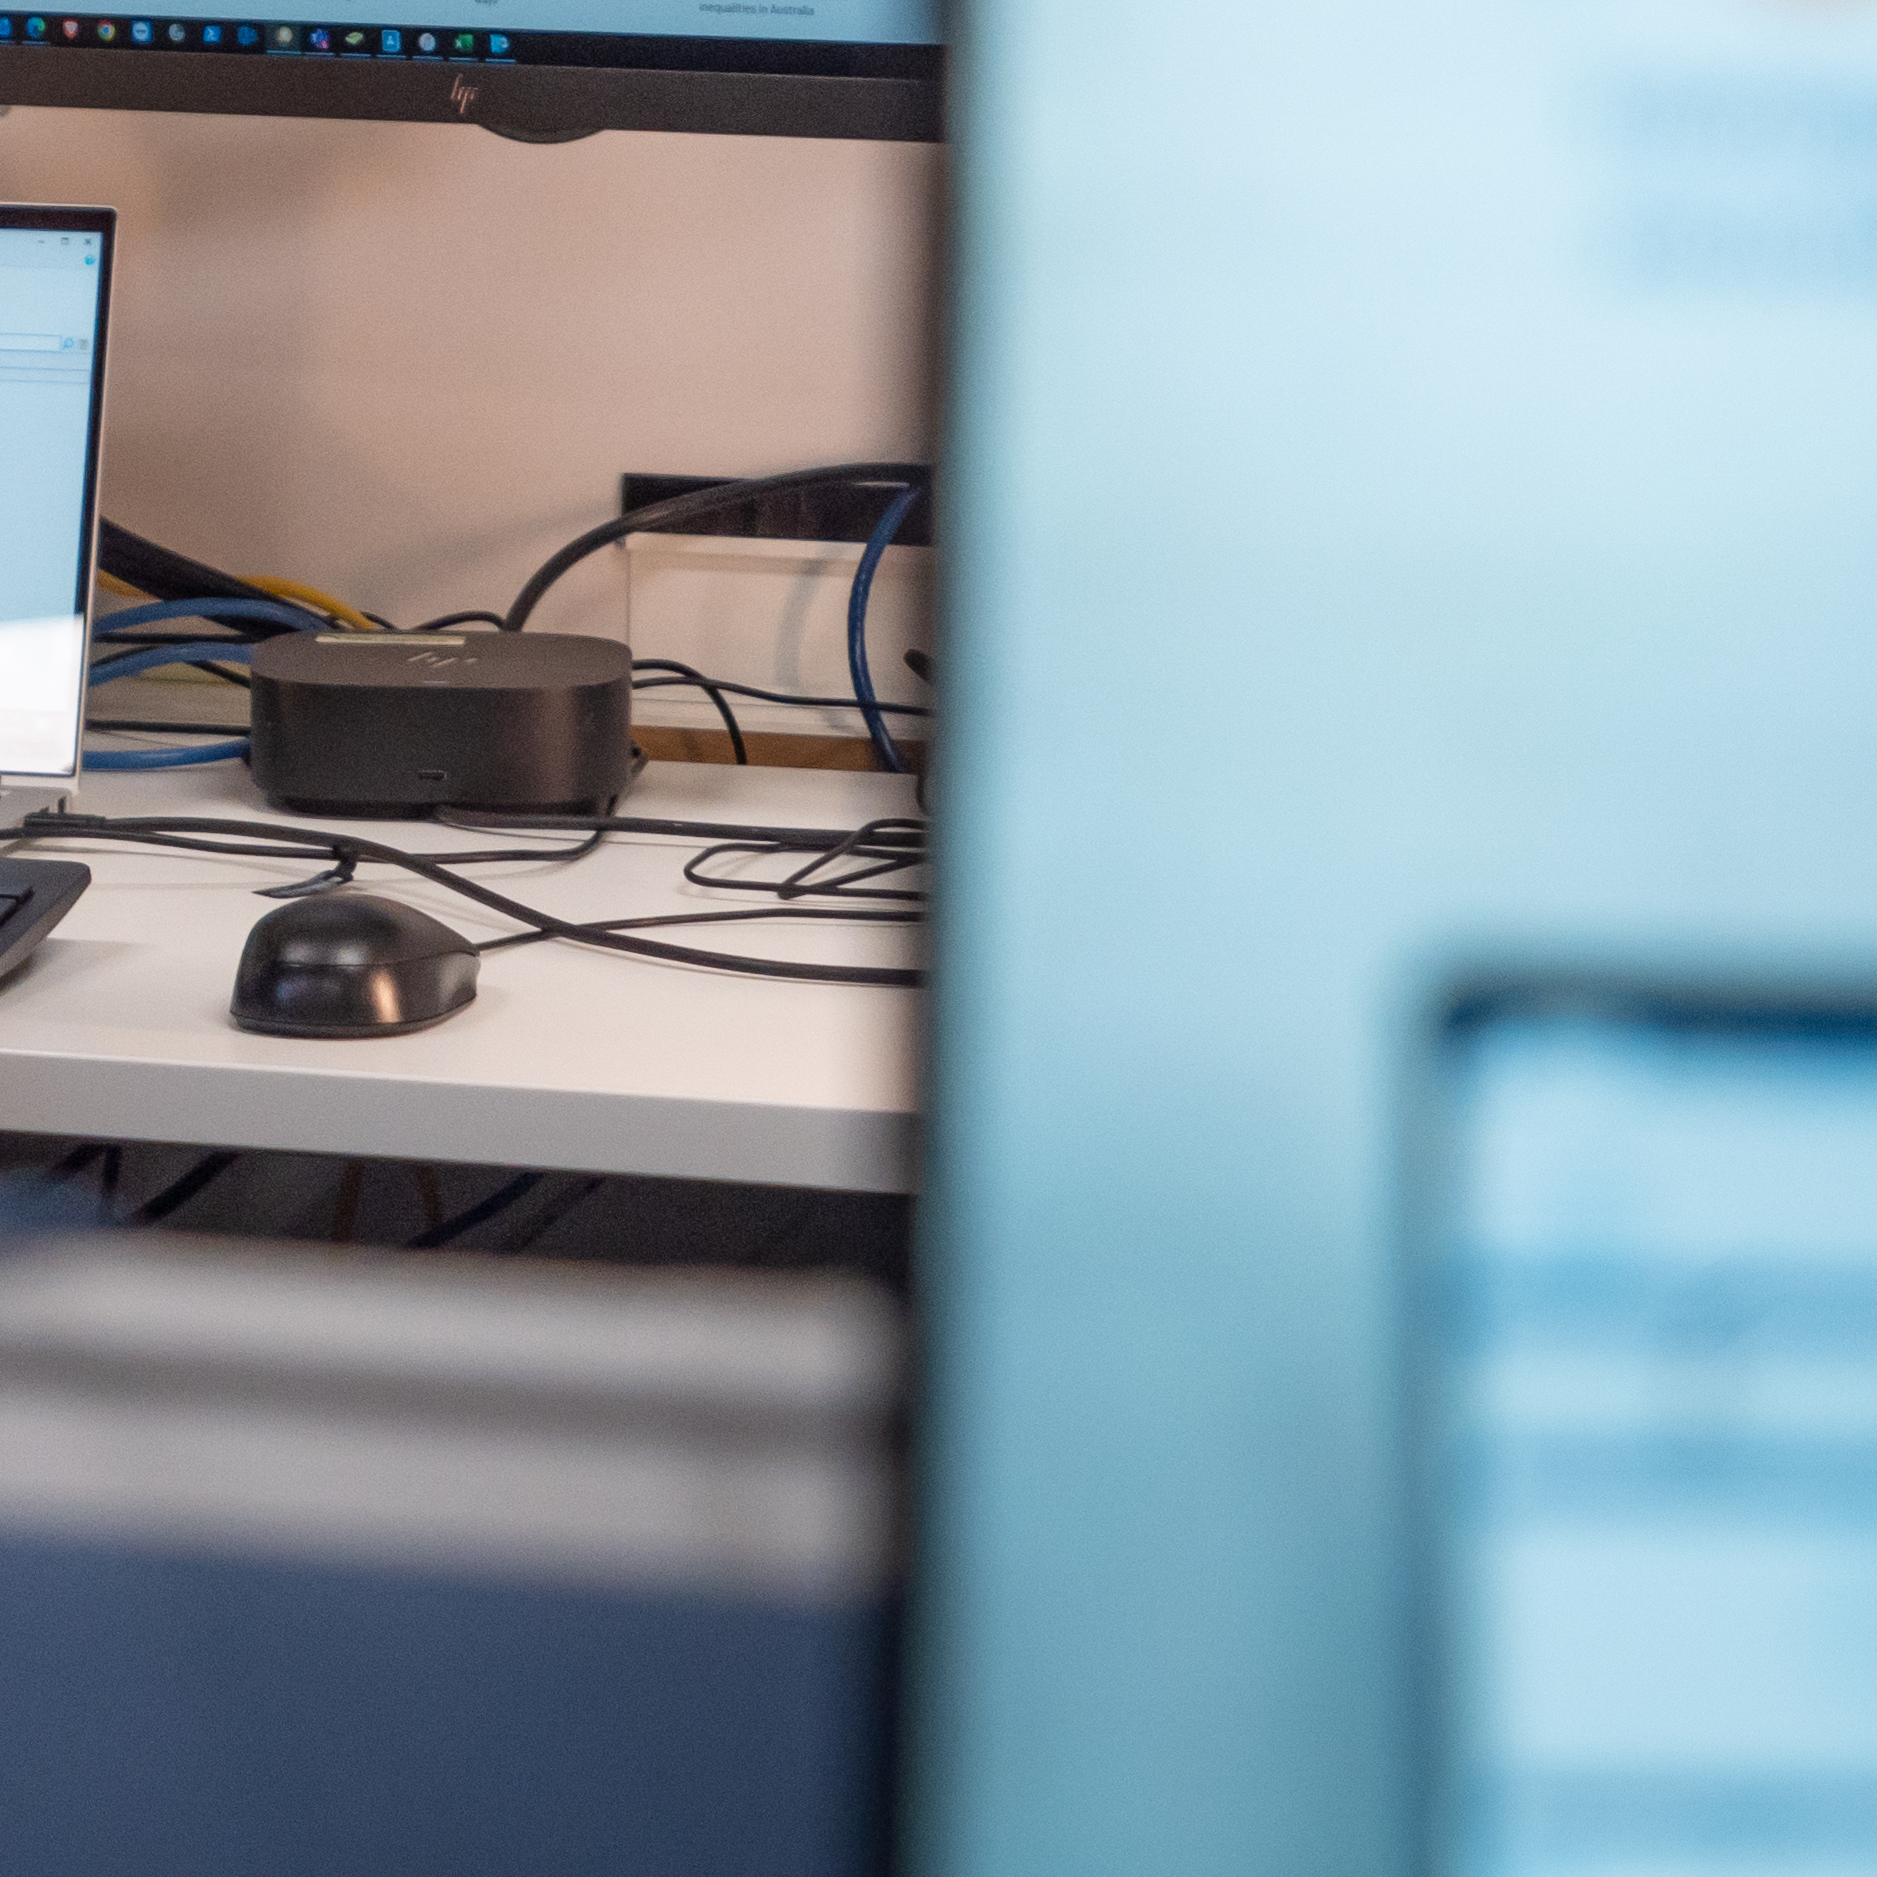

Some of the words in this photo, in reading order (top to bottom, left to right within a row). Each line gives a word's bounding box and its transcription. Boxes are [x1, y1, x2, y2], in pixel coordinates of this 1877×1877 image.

[699, 2, 756, 16] inequalities
[758, 3, 768, 14] in
[770, 4, 815, 17] Australia
